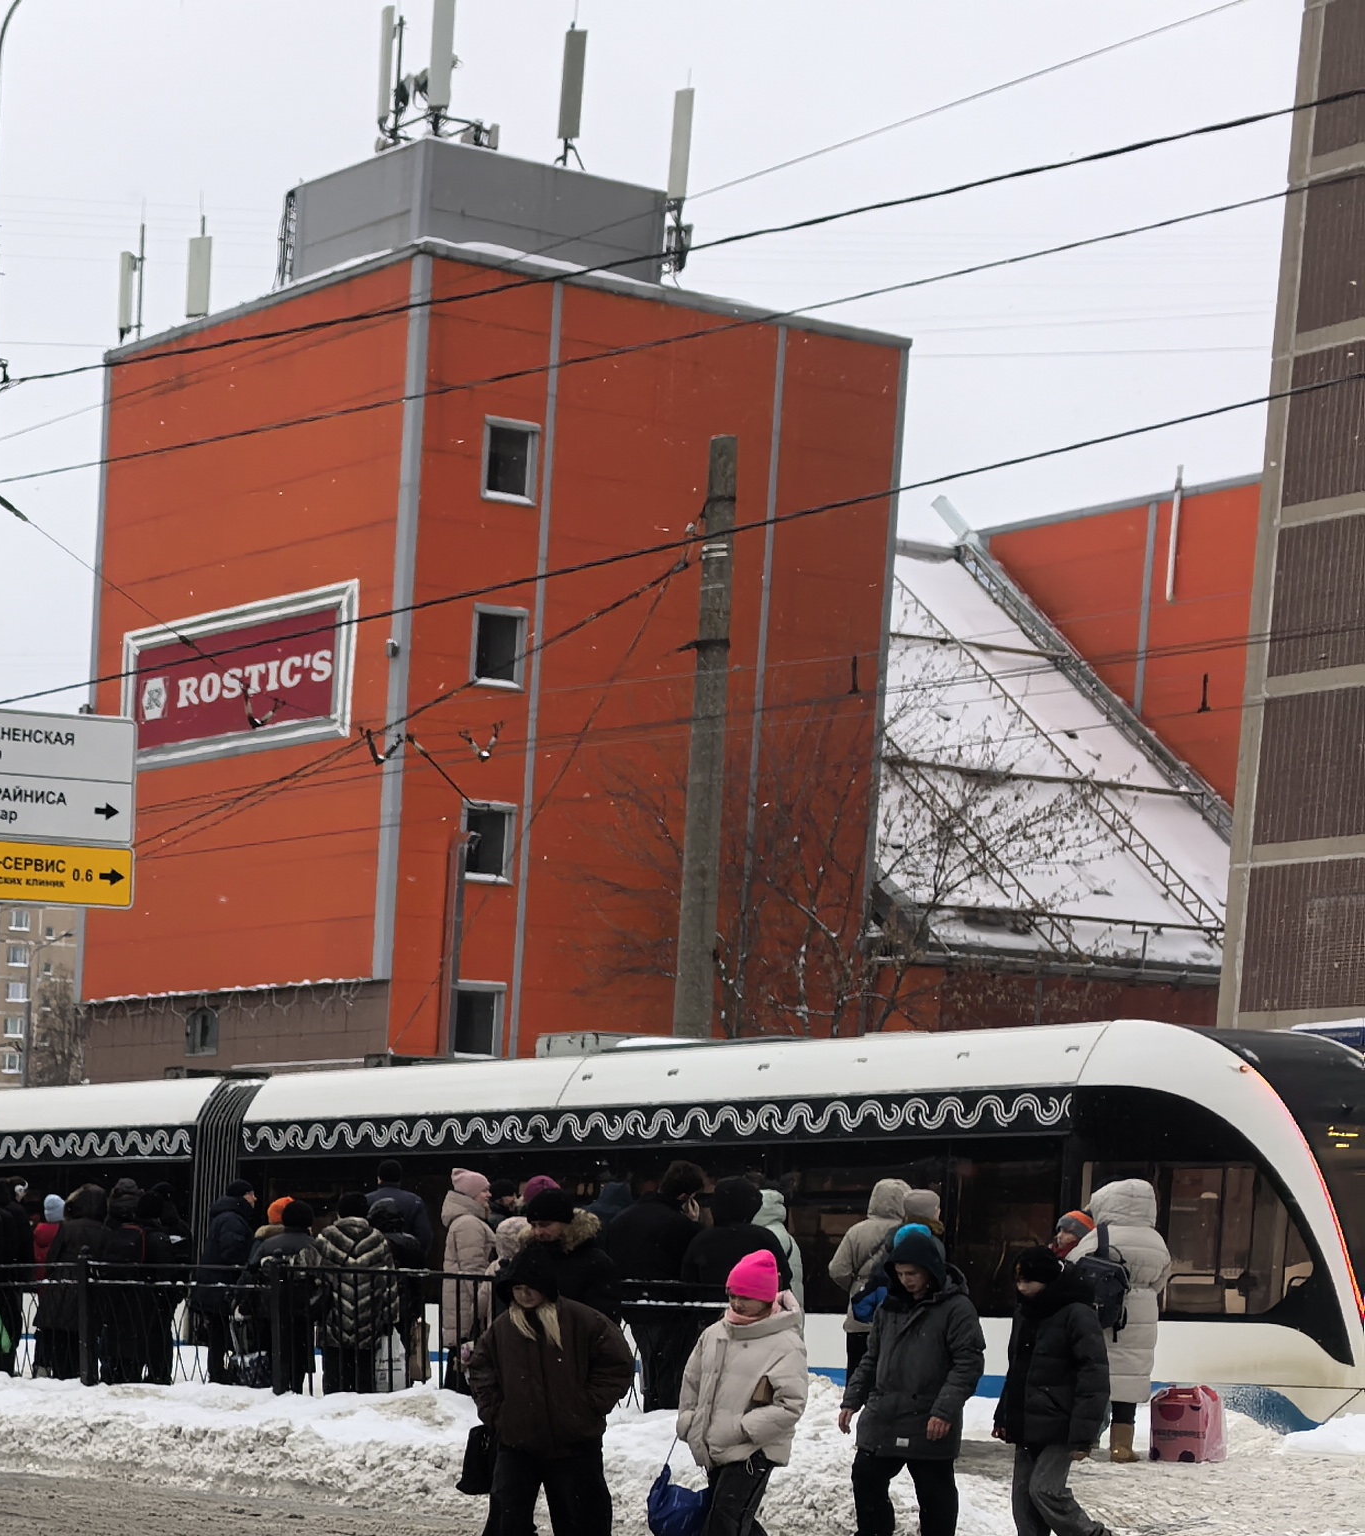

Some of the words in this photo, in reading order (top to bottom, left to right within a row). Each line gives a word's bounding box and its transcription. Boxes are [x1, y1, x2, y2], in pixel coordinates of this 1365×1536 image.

[176, 649, 333, 709] ROSTIC'S
[72, 868, 94, 882] 0.6
[25, 877, 66, 888] клиник
